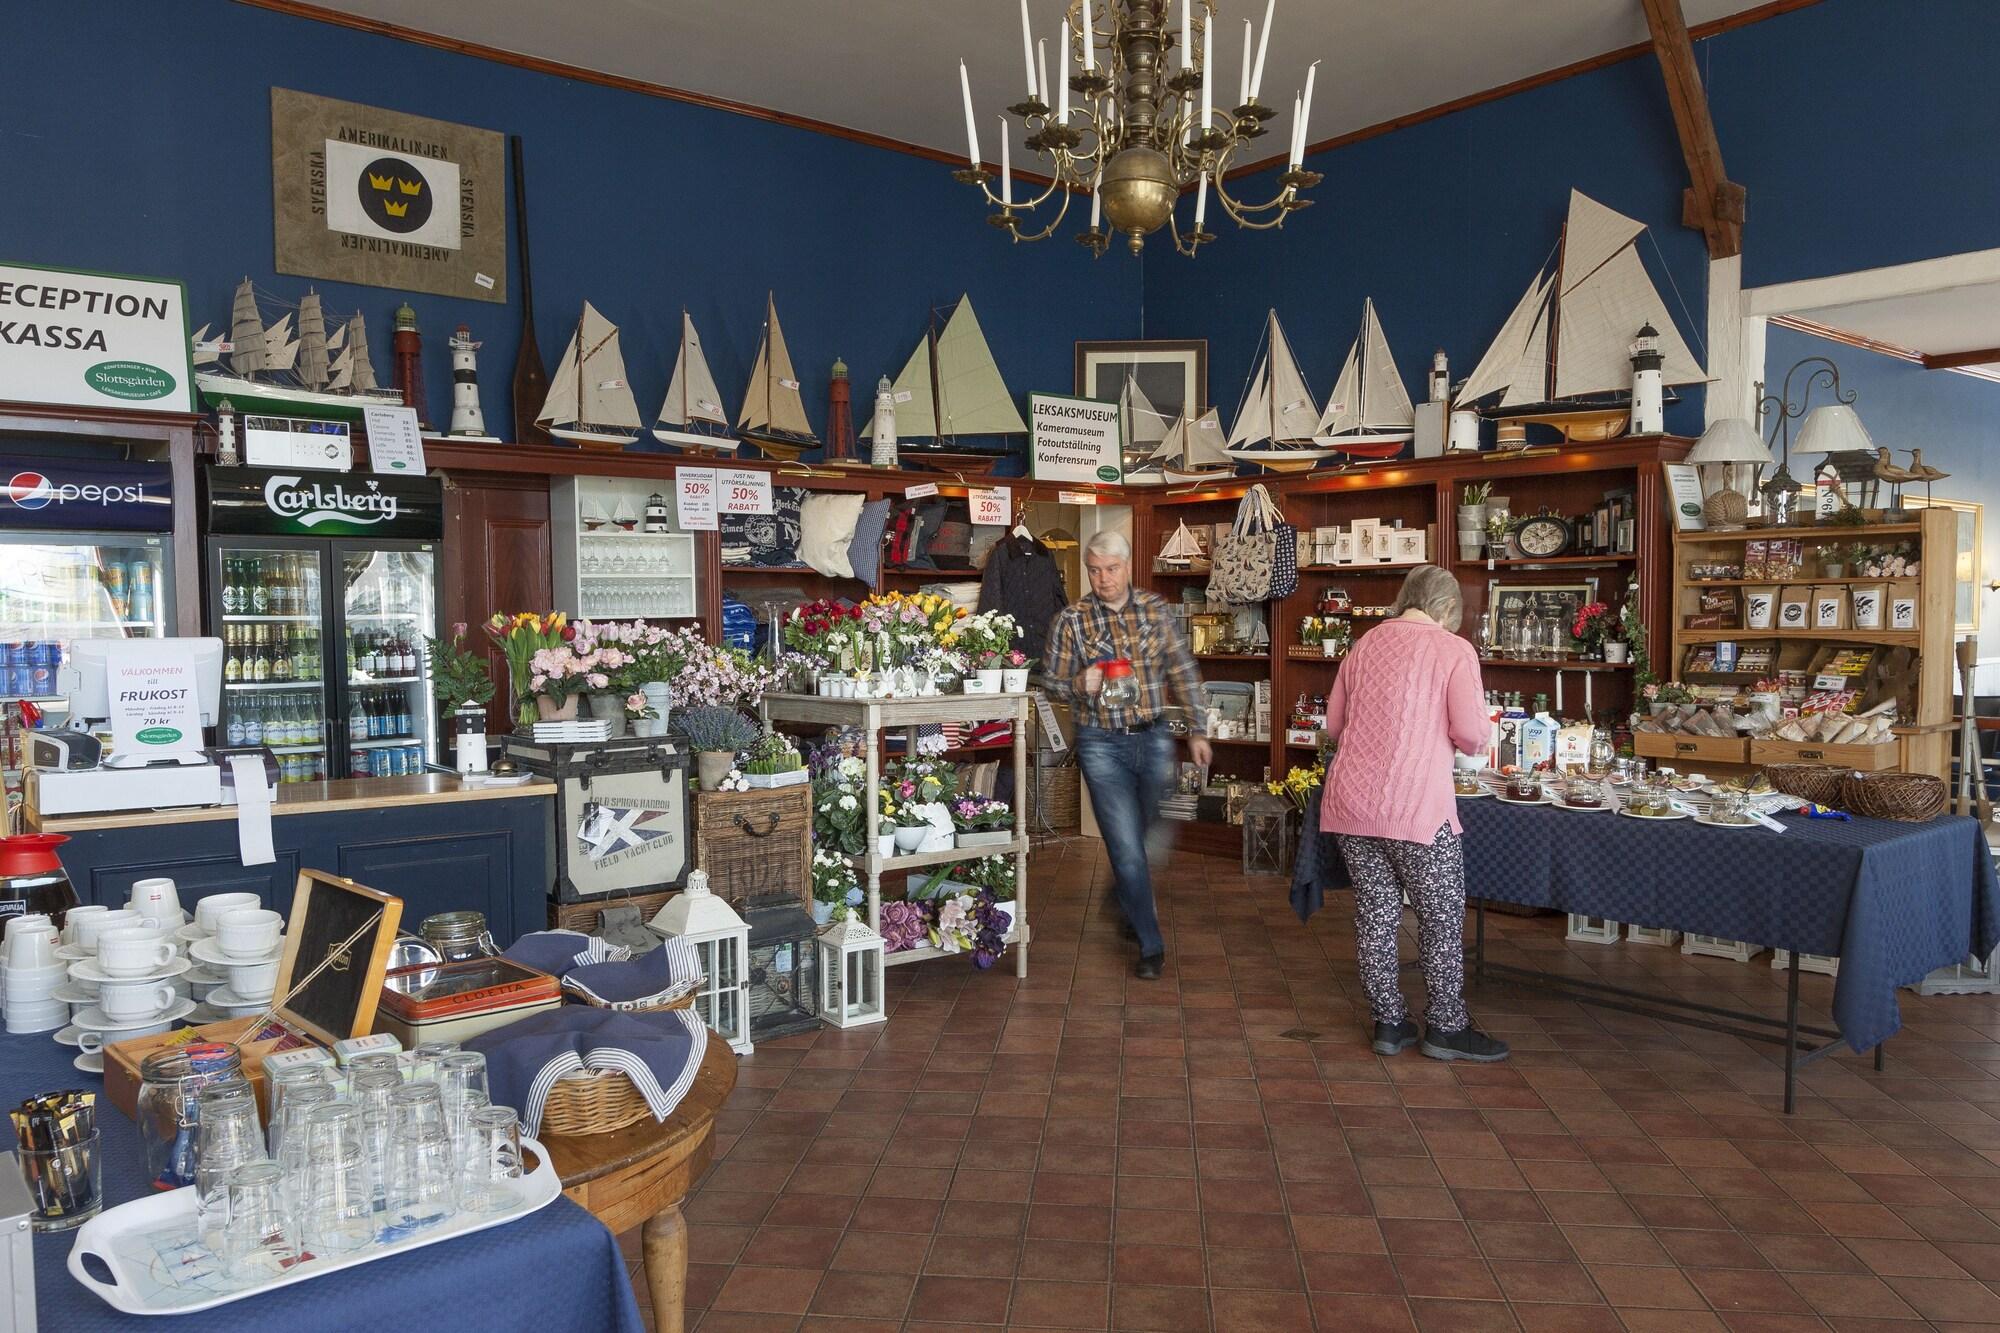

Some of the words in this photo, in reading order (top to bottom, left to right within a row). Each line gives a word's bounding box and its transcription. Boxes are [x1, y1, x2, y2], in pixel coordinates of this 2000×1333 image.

[338, 126, 449, 160] AMERIKALINJEN
[311, 151, 325, 215] SVENSKA
[461, 178, 475, 238] SVENSKA
[341, 234, 449, 262] AMERIKALINJEN
[0, 321, 107, 352] KASSA
[95, 372, 166, 387] Slottsgården
[1033, 403, 1118, 423] LEKSAKSMUSEUM
[1036, 421, 1105, 437] Kameramuseum
[1037, 437, 1102, 454] Fotoutställning
[1038, 452, 1097, 466] Konferensrum
[59, 483, 143, 505] pepsi
[684, 482, 710, 495] 50%
[731, 488, 759, 501] 50%
[264, 475, 398, 520] Carlsberg
[727, 502, 760, 511] RABATT
[979, 501, 1001, 513] 50%
[120, 688, 188, 702] FRUKOST
[159, 717, 171, 725] kr
[610, 797, 638, 808] SPRING
[594, 854, 619, 870] FIELD
[624, 842, 651, 859] YACHT
[653, 834, 674, 849] CLUB
[453, 984, 526, 1003] CLOETTA
